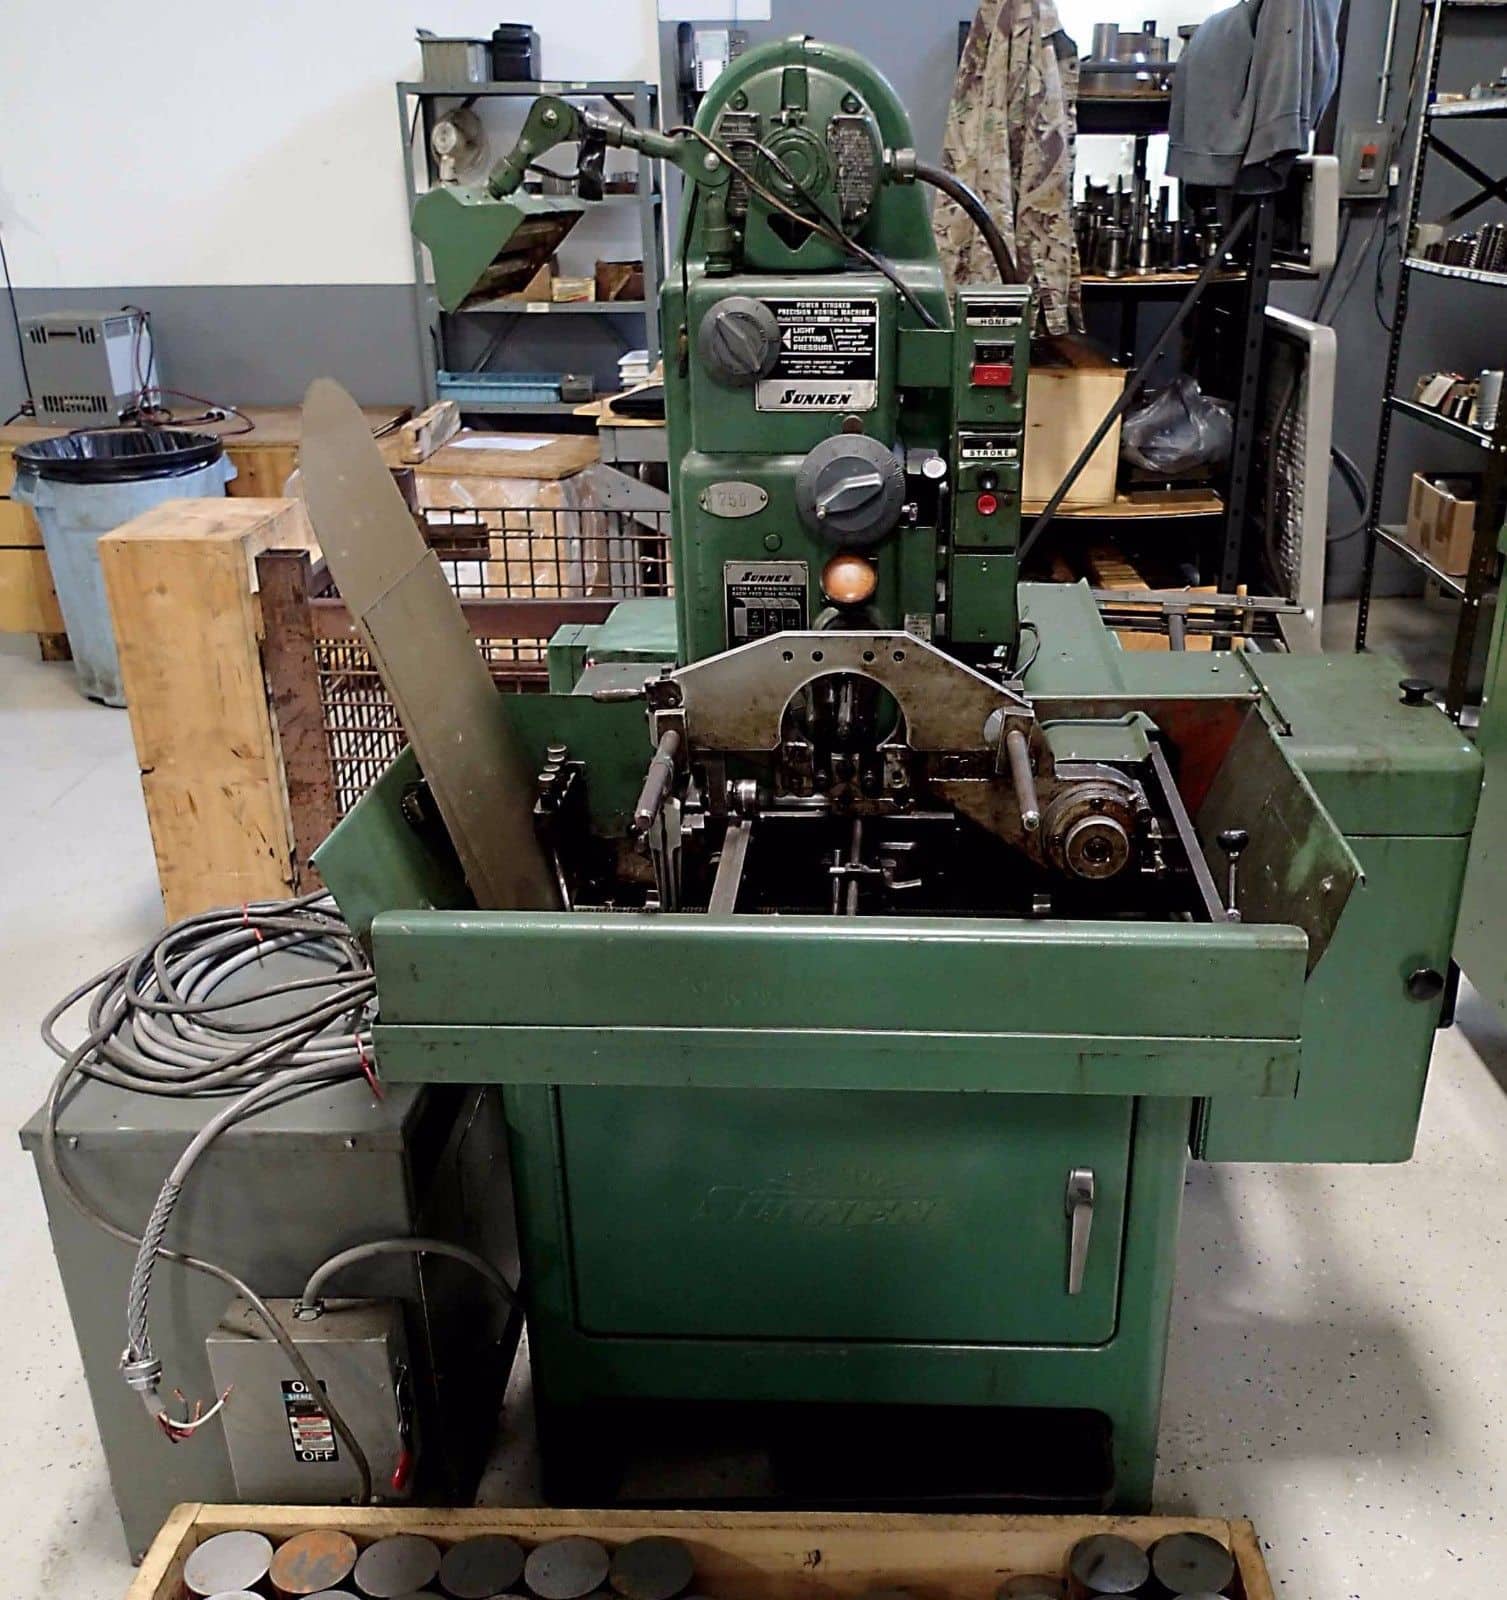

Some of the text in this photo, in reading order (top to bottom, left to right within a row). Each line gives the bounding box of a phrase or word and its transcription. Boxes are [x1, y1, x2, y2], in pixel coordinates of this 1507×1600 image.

[792, 335, 827, 343] CUTTING
[780, 389, 852, 405] SUNNEN
[969, 448, 1009, 456] STROKE
[741, 571, 793, 582] SUNNEN
[302, 1450, 333, 1461] OFF
